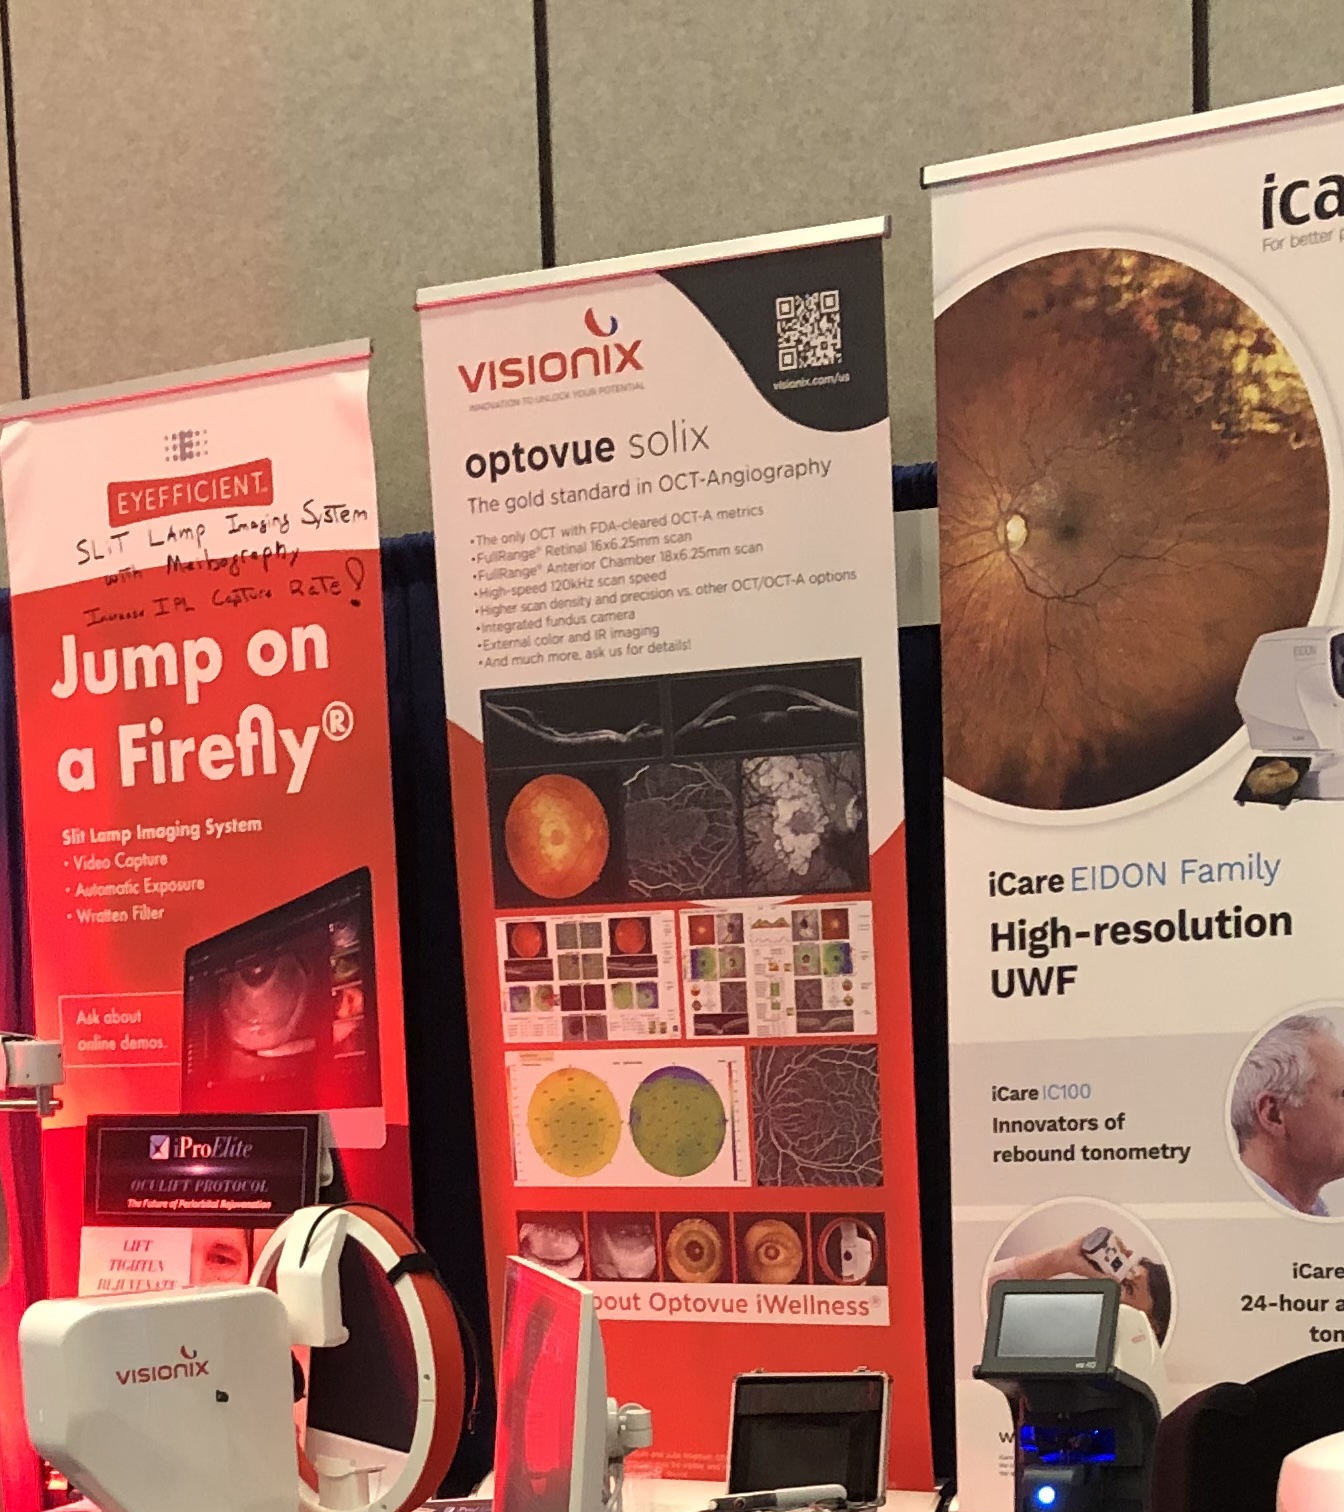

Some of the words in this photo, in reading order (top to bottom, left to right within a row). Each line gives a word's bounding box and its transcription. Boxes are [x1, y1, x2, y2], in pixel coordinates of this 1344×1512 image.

[1262, 236, 1286, 252] For
[1290, 228, 1335, 249] better
[458, 339, 644, 393] VISIONIX
[773, 372, 850, 390] visionix.com/us
[469, 398, 520, 412] INNOVATION
[522, 396, 533, 406] TO
[535, 392, 570, 405] UNLOCK
[573, 387, 598, 399] YOUR
[598, 381, 645, 395] POTENTIAL
[465, 435, 615, 483] optovue
[629, 418, 710, 460] solix
[118, 472, 264, 514] EYEFFICIENT
[467, 496, 500, 515] The
[505, 490, 545, 515] gold
[550, 479, 630, 506] standard
[636, 478, 653, 495] in
[659, 457, 832, 493] OCT-Angiography
[476, 535, 497, 547] The
[500, 531, 526, 545] only
[529, 526, 556, 541] OCT
[560, 523, 586, 537] with
[590, 514, 667, 534] FDA-cleared
[671, 509, 713, 526] OCT-A
[716, 505, 764, 520] metrics
[545, 542, 587, 556] Retinal
[590, 535, 660, 551] 16x6.25mm
[664, 531, 692, 544] scan
[546, 559, 596, 574] Anterior
[600, 552, 656, 569] Chamber
[660, 546, 731, 562] 18x6.25mm
[734, 542, 764, 555] scan
[479, 581, 547, 600] High-speed
[550, 577, 593, 592] 120kHz
[597, 575, 625, 587] scan
[629, 569, 667, 586] speed
[480, 602, 517, 618] Higher
[520, 600, 547, 612] scan
[549, 594, 592, 610] density
[595, 592, 617, 604] and
[620, 584, 674, 604] precision
[677, 587, 693, 597] vs.
[696, 581, 728, 595] other
[731, 573, 805, 592] OCT/OCT-A
[809, 569, 857, 585] options
[481, 617, 542, 634] Integrated
[546, 614, 587, 627] fundus
[590, 610, 635, 623] camera
[483, 636, 531, 651] External
[534, 632, 564, 646] color
[568, 631, 591, 643] and
[595, 628, 606, 640] IR
[610, 625, 660, 643] imaging
[51, 634, 223, 705] Jump
[247, 623, 329, 677] on
[484, 655, 508, 668] And
[511, 651, 544, 666] much
[547, 650, 582, 663] more,
[585, 645, 605, 659] ask
[609, 646, 623, 657] us
[626, 642, 643, 655] for
[647, 639, 691, 654] details!
[57, 747, 95, 792] a
[118, 700, 355, 794] Firefly®
[62, 828, 86, 846] Slit
[90, 827, 132, 846] Lamp
[136, 820, 200, 843] Imaging
[205, 818, 263, 839] System
[73, 853, 111, 871] Video
[114, 851, 168, 872] Capture
[988, 870, 1065, 897] iCare
[1071, 861, 1167, 892] EIDON
[1181, 852, 1281, 887] Family
[75, 879, 140, 898] Automatic
[143, 877, 205, 897] Exposure
[990, 905, 1293, 959] High-resolution
[990, 964, 1078, 999] UWF
[76, 1009, 100, 1025] Ask
[103, 1008, 142, 1025] about
[77, 1035, 116, 1052] online
[991, 1085, 1039, 1101] iCare
[1043, 1083, 1091, 1100] IC100
[992, 1115, 1099, 1133] Innovators
[1104, 1112, 1126, 1130] of
[174, 1136, 253, 1158] iProElite
[992, 1144, 1075, 1162] rebound
[1081, 1143, 1191, 1164] tonometry
[194, 1179, 269, 1193] PROTOCOL
[128, 1198, 142, 1208] The
[143, 1198, 169, 1208] Future
[169, 1199, 178, 1211] of
[123, 1239, 154, 1252] LIFT
[109, 1259, 166, 1272] TIGHTEN
[649, 1291, 749, 1316] Optovue
[1241, 1294, 1329, 1312] 24-hour
[115, 1360, 209, 1385] VISIONIX
